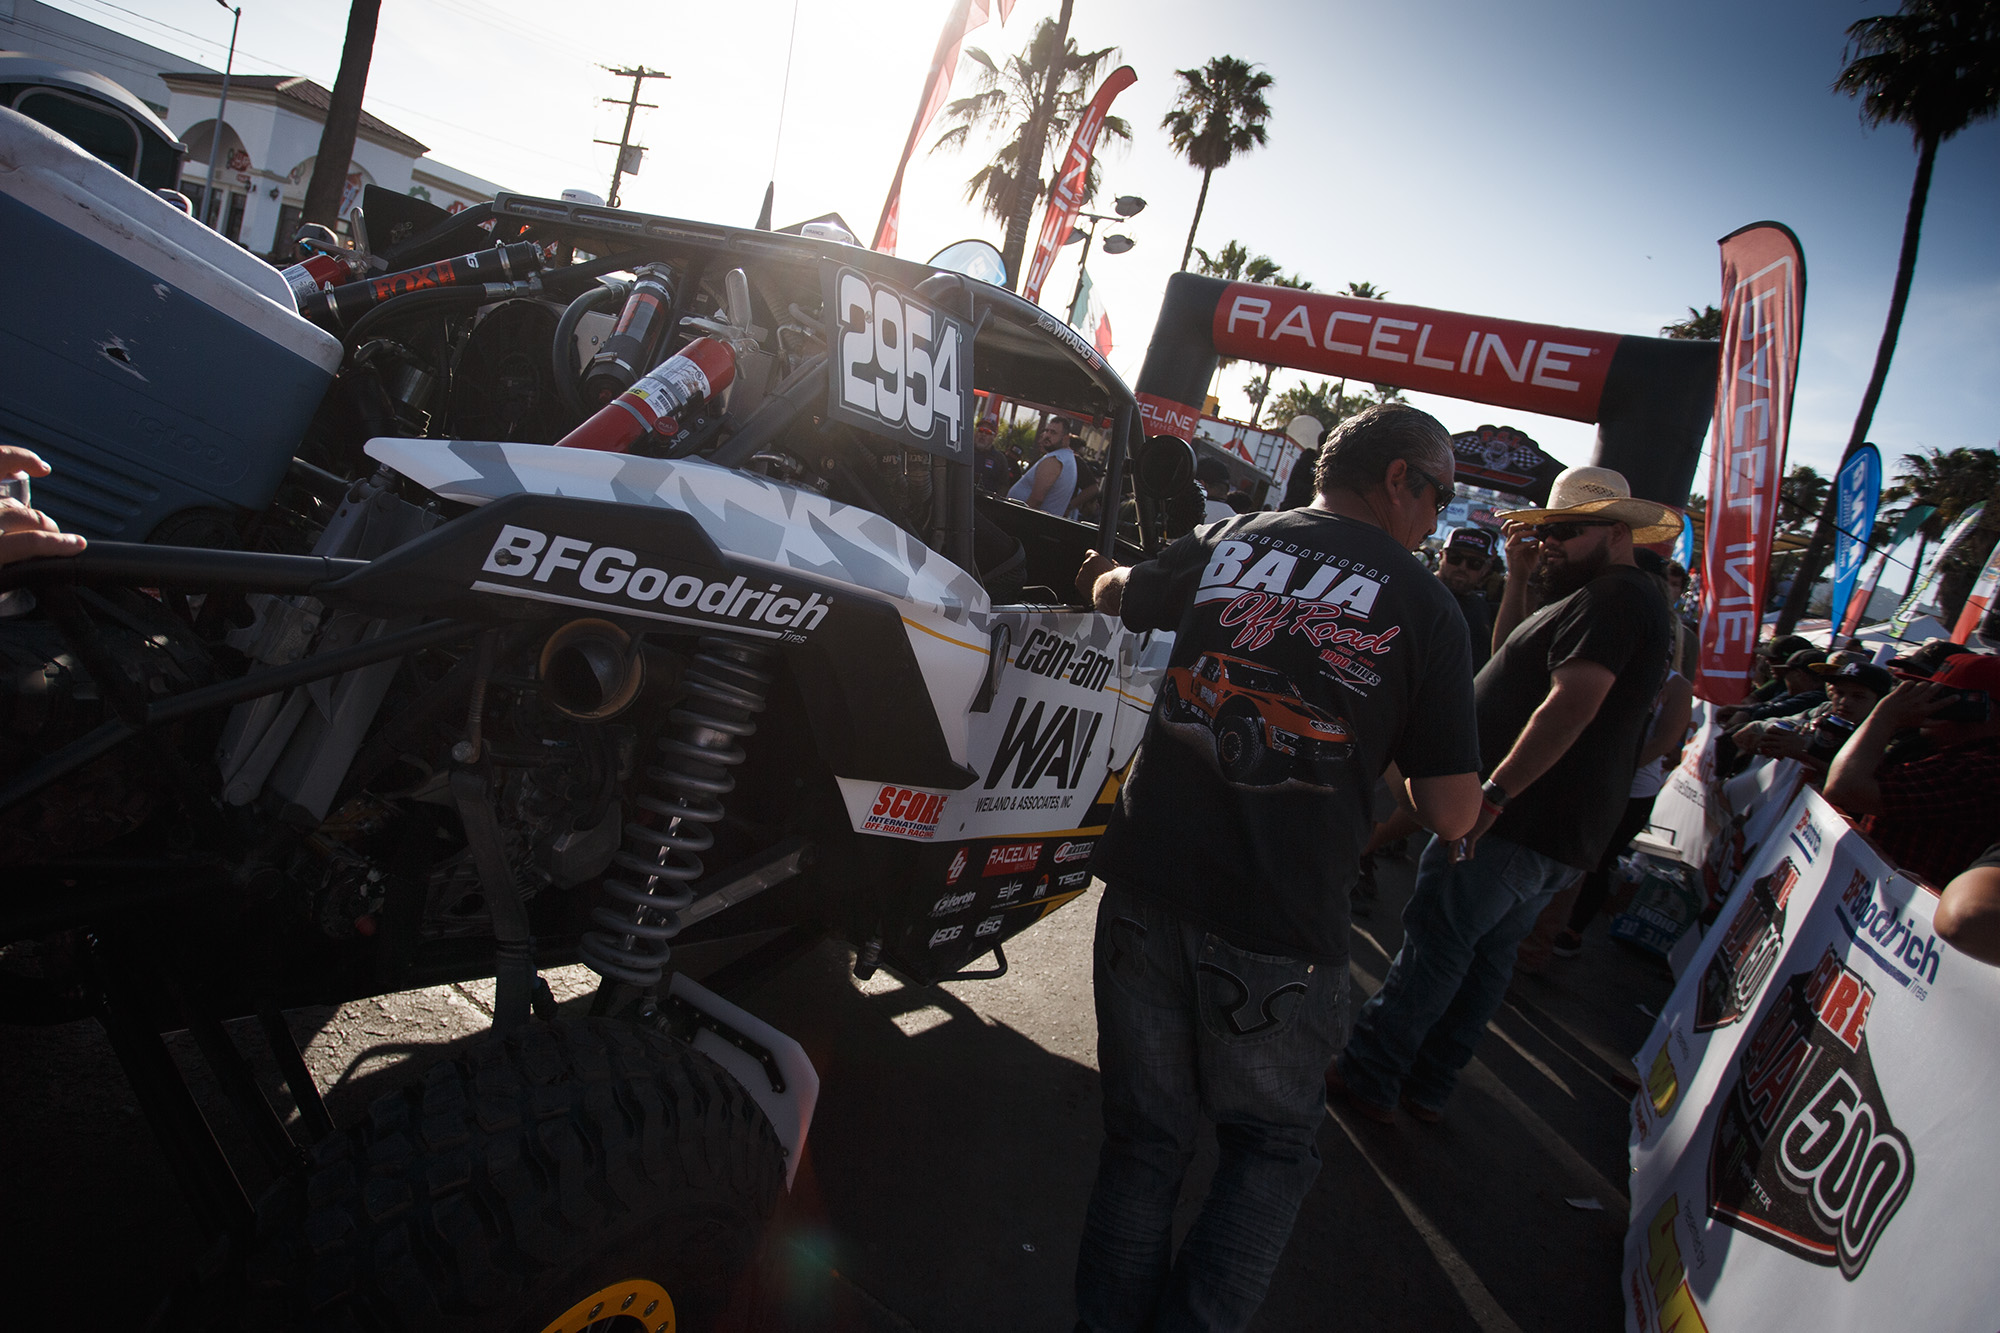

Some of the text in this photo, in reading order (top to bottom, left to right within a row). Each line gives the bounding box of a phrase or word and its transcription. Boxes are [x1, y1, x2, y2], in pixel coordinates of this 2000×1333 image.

[839, 272, 964, 444] 2954
[1052, 322, 1093, 361] WRAGG
[1227, 295, 1592, 392] RACELINE
[1138, 401, 1193, 431] ELINE
[1150, 419, 1191, 438] WHEELS
[481, 523, 829, 631] BFGoodrich
[1199, 539, 1382, 614] BAJA
[1226, 531, 1391, 584] INTERNATIONAL
[780, 629, 807, 644] Tires
[1219, 591, 1402, 656] Off Road
[1319, 648, 1382, 687] 1000 MILES
[867, 814, 937, 833] INTERNATIONAL
[872, 785, 948, 825] SCORE
[975, 795, 1073, 813] WEILAND & ASSOCIATES, INC
[864, 821, 935, 839] OFF-ROAD RACING
[986, 845, 1042, 866] RACELINE
[1058, 870, 1086, 886] TSCO
[947, 891, 976, 907] fortin
[1841, 867, 1941, 986] BFGoodrich
[1908, 977, 1928, 1002] Tires
[1781, 1067, 1908, 1258] 500
